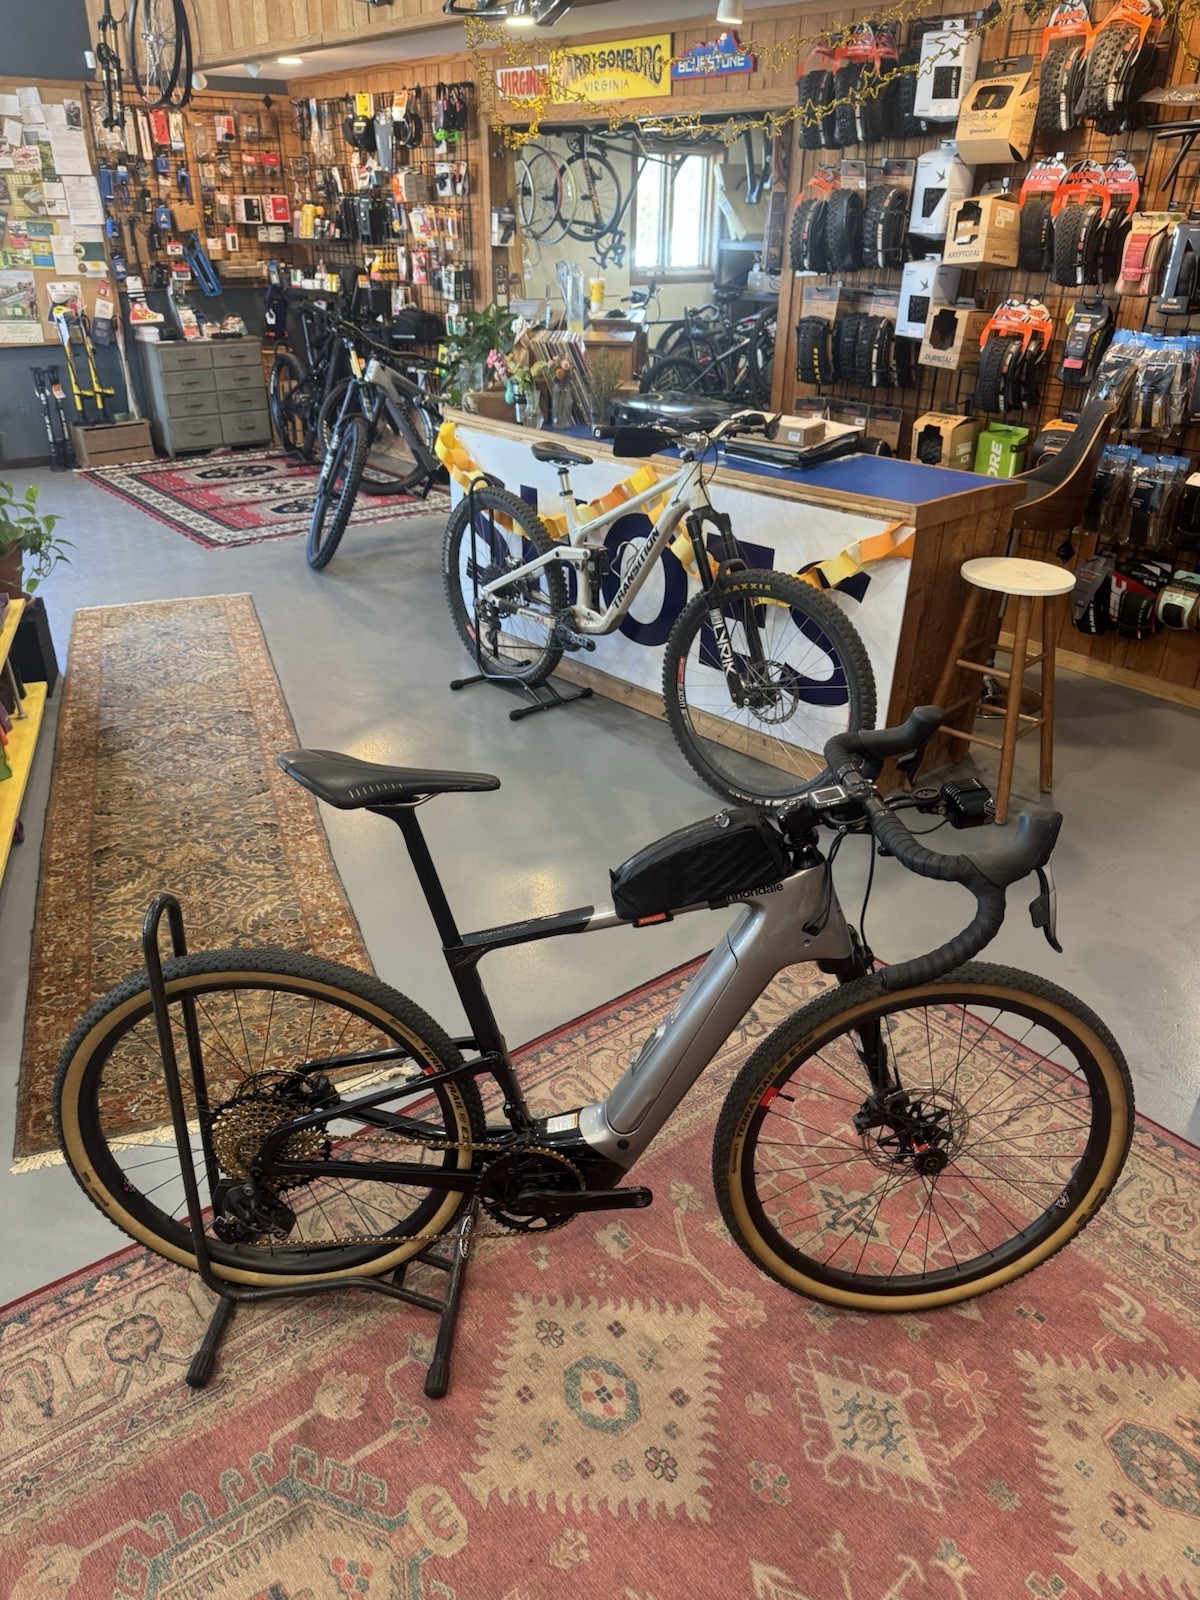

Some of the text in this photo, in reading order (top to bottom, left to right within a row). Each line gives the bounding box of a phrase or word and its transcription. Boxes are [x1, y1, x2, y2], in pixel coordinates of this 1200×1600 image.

[500, 66, 547, 96] VIRGINI
[560, 44, 664, 85] ARRISONBURG
[583, 80, 630, 92] VIRGINIA
[611, 526, 662, 610] TRANSITION
[723, 582, 772, 595] MAXXIS
[711, 621, 738, 676] LYRIK
[726, 883, 784, 902] nnondale
[736, 1102, 758, 1139] TERRA
[753, 1070, 781, 1103] TRAIL
